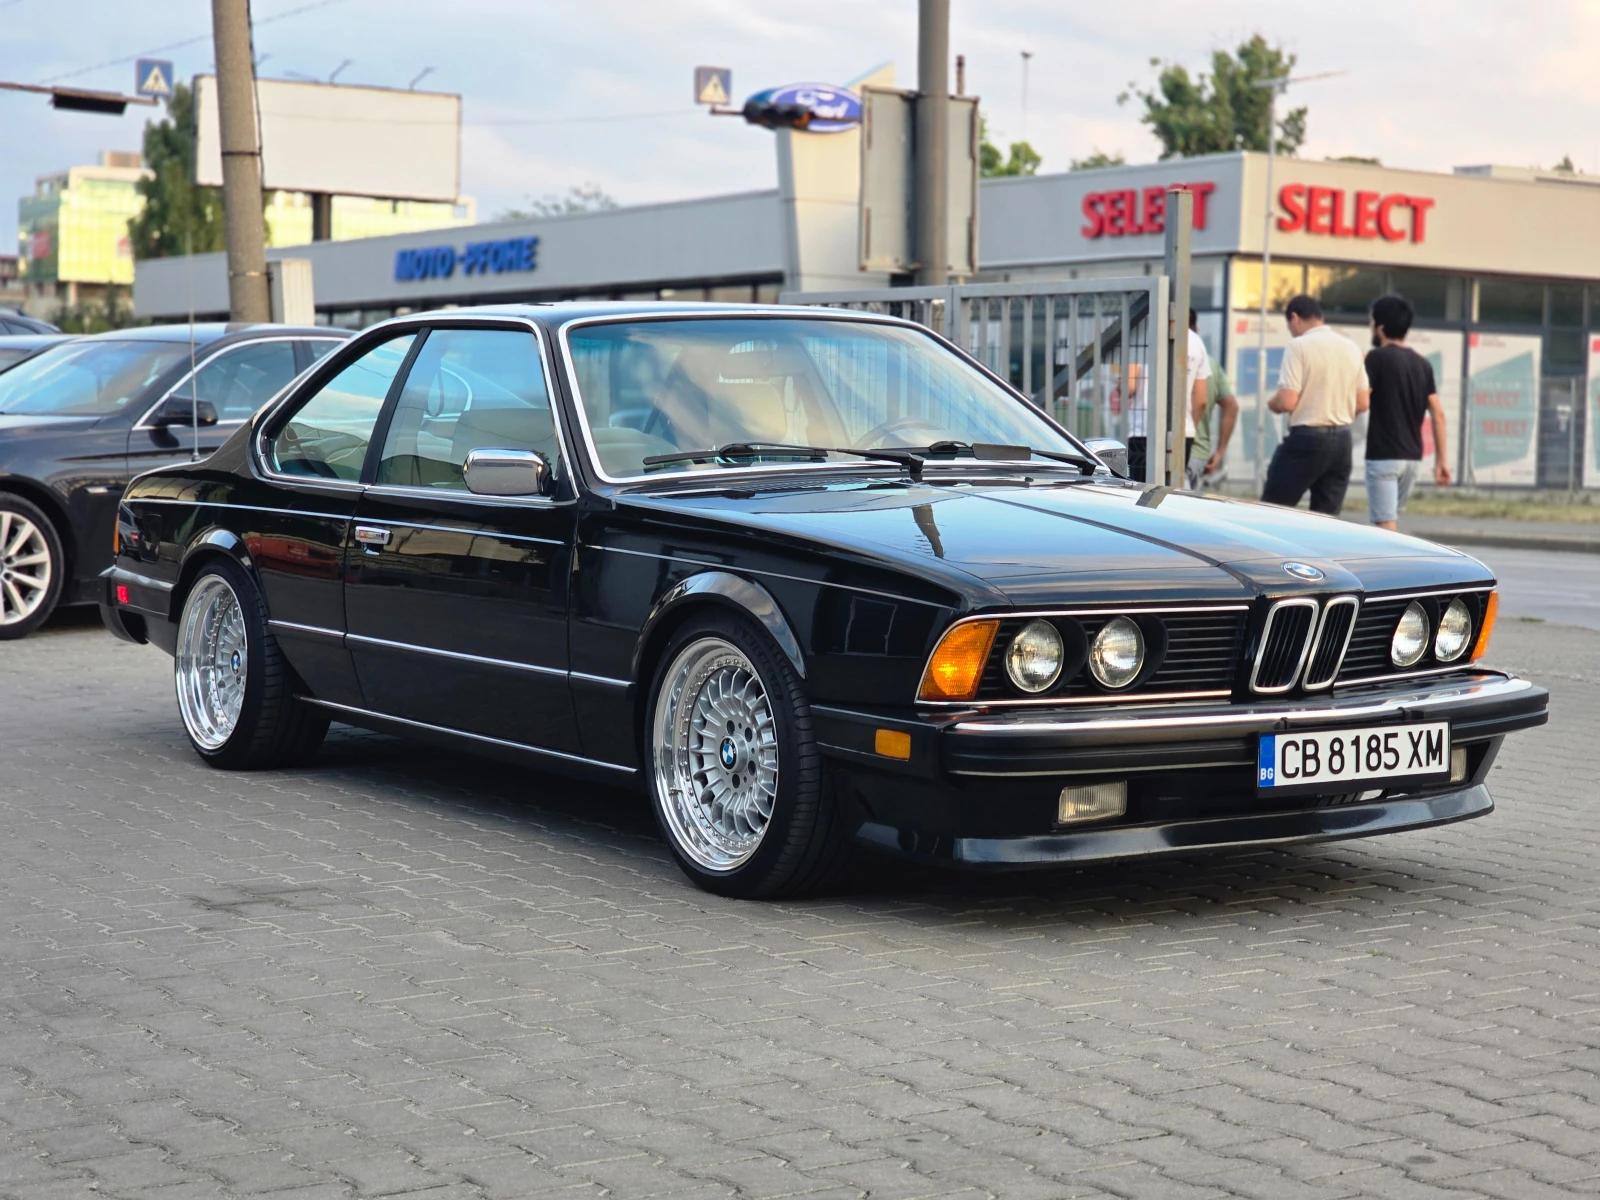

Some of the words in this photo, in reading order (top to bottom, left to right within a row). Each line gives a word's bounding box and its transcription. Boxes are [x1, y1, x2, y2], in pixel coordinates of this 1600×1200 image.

[1082, 182, 1215, 238] SELET
[1277, 182, 1435, 244] SELECT
[1482, 418, 1527, 436] SELECT
[1260, 768, 1273, 780] BG
[1281, 739, 1321, 778] CB
[1328, 732, 1400, 774] 8185
[1407, 729, 1443, 769] XM
